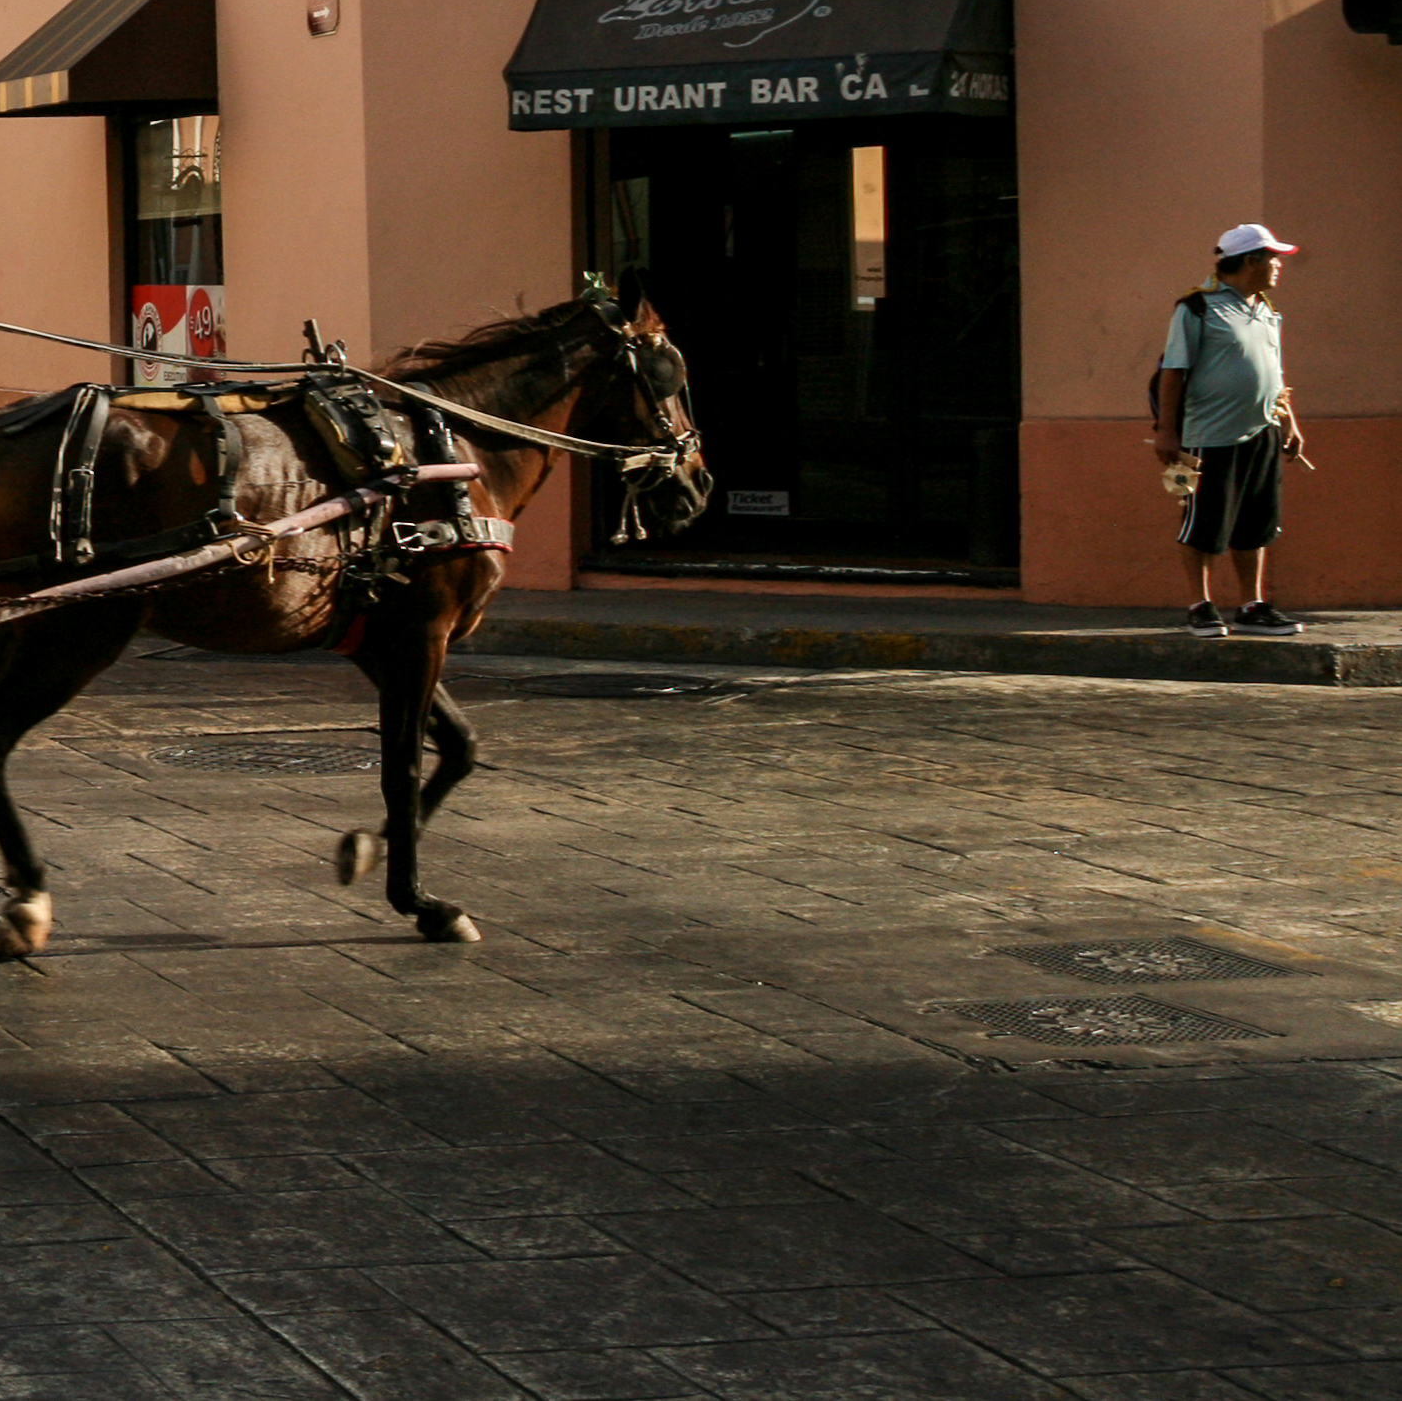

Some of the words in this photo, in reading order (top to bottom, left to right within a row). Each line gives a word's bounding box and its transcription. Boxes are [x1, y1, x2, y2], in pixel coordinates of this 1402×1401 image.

[634, 14, 710, 40] Desde
[714, 8, 775, 31] 1952
[750, 77, 819, 104] BAR
[195, 306, 212, 339] 49
